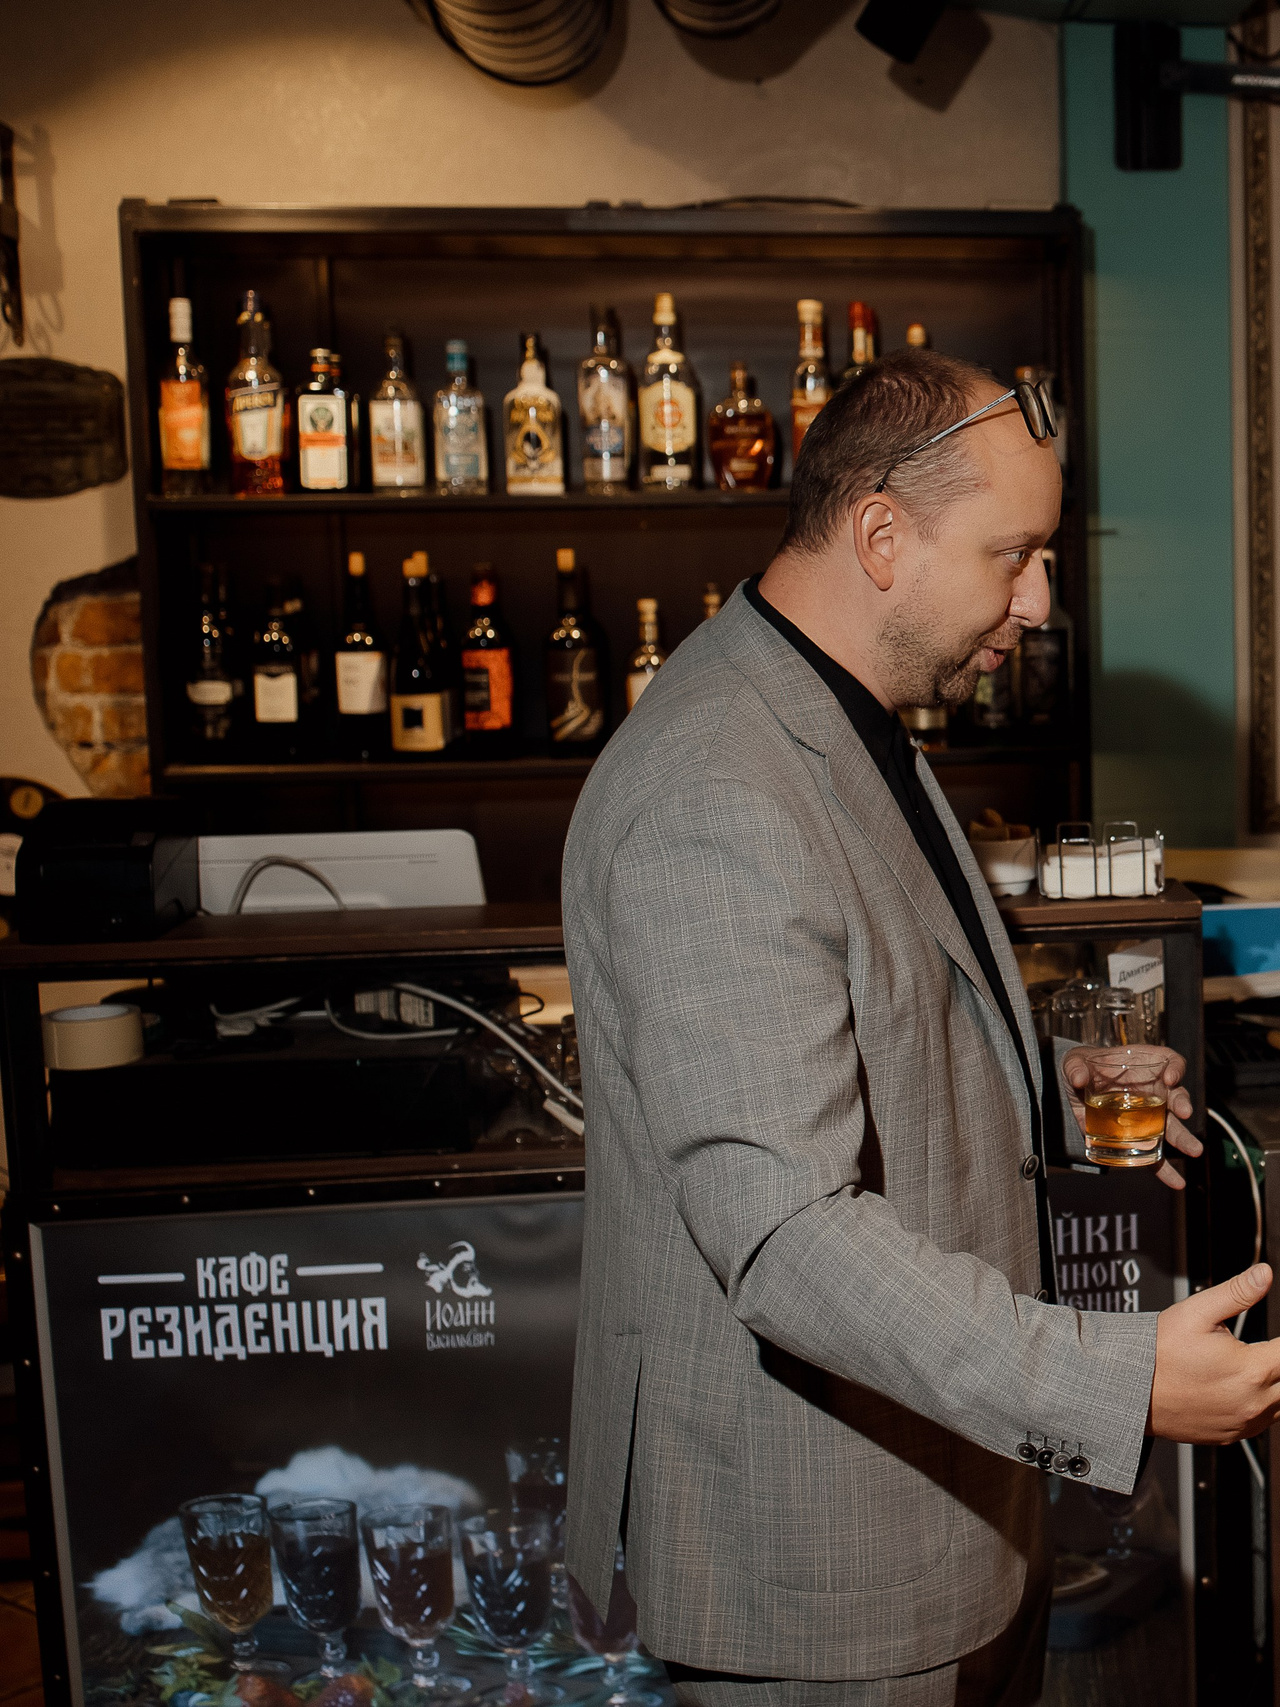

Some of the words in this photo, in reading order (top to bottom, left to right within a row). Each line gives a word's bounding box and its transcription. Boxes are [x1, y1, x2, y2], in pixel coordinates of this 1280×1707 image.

[196, 1252, 289, 1298] КАФЕ
[100, 1297, 388, 1361] РЕЗИДЕНЦИЯ
[425, 1299, 495, 1331] ИОАНН
